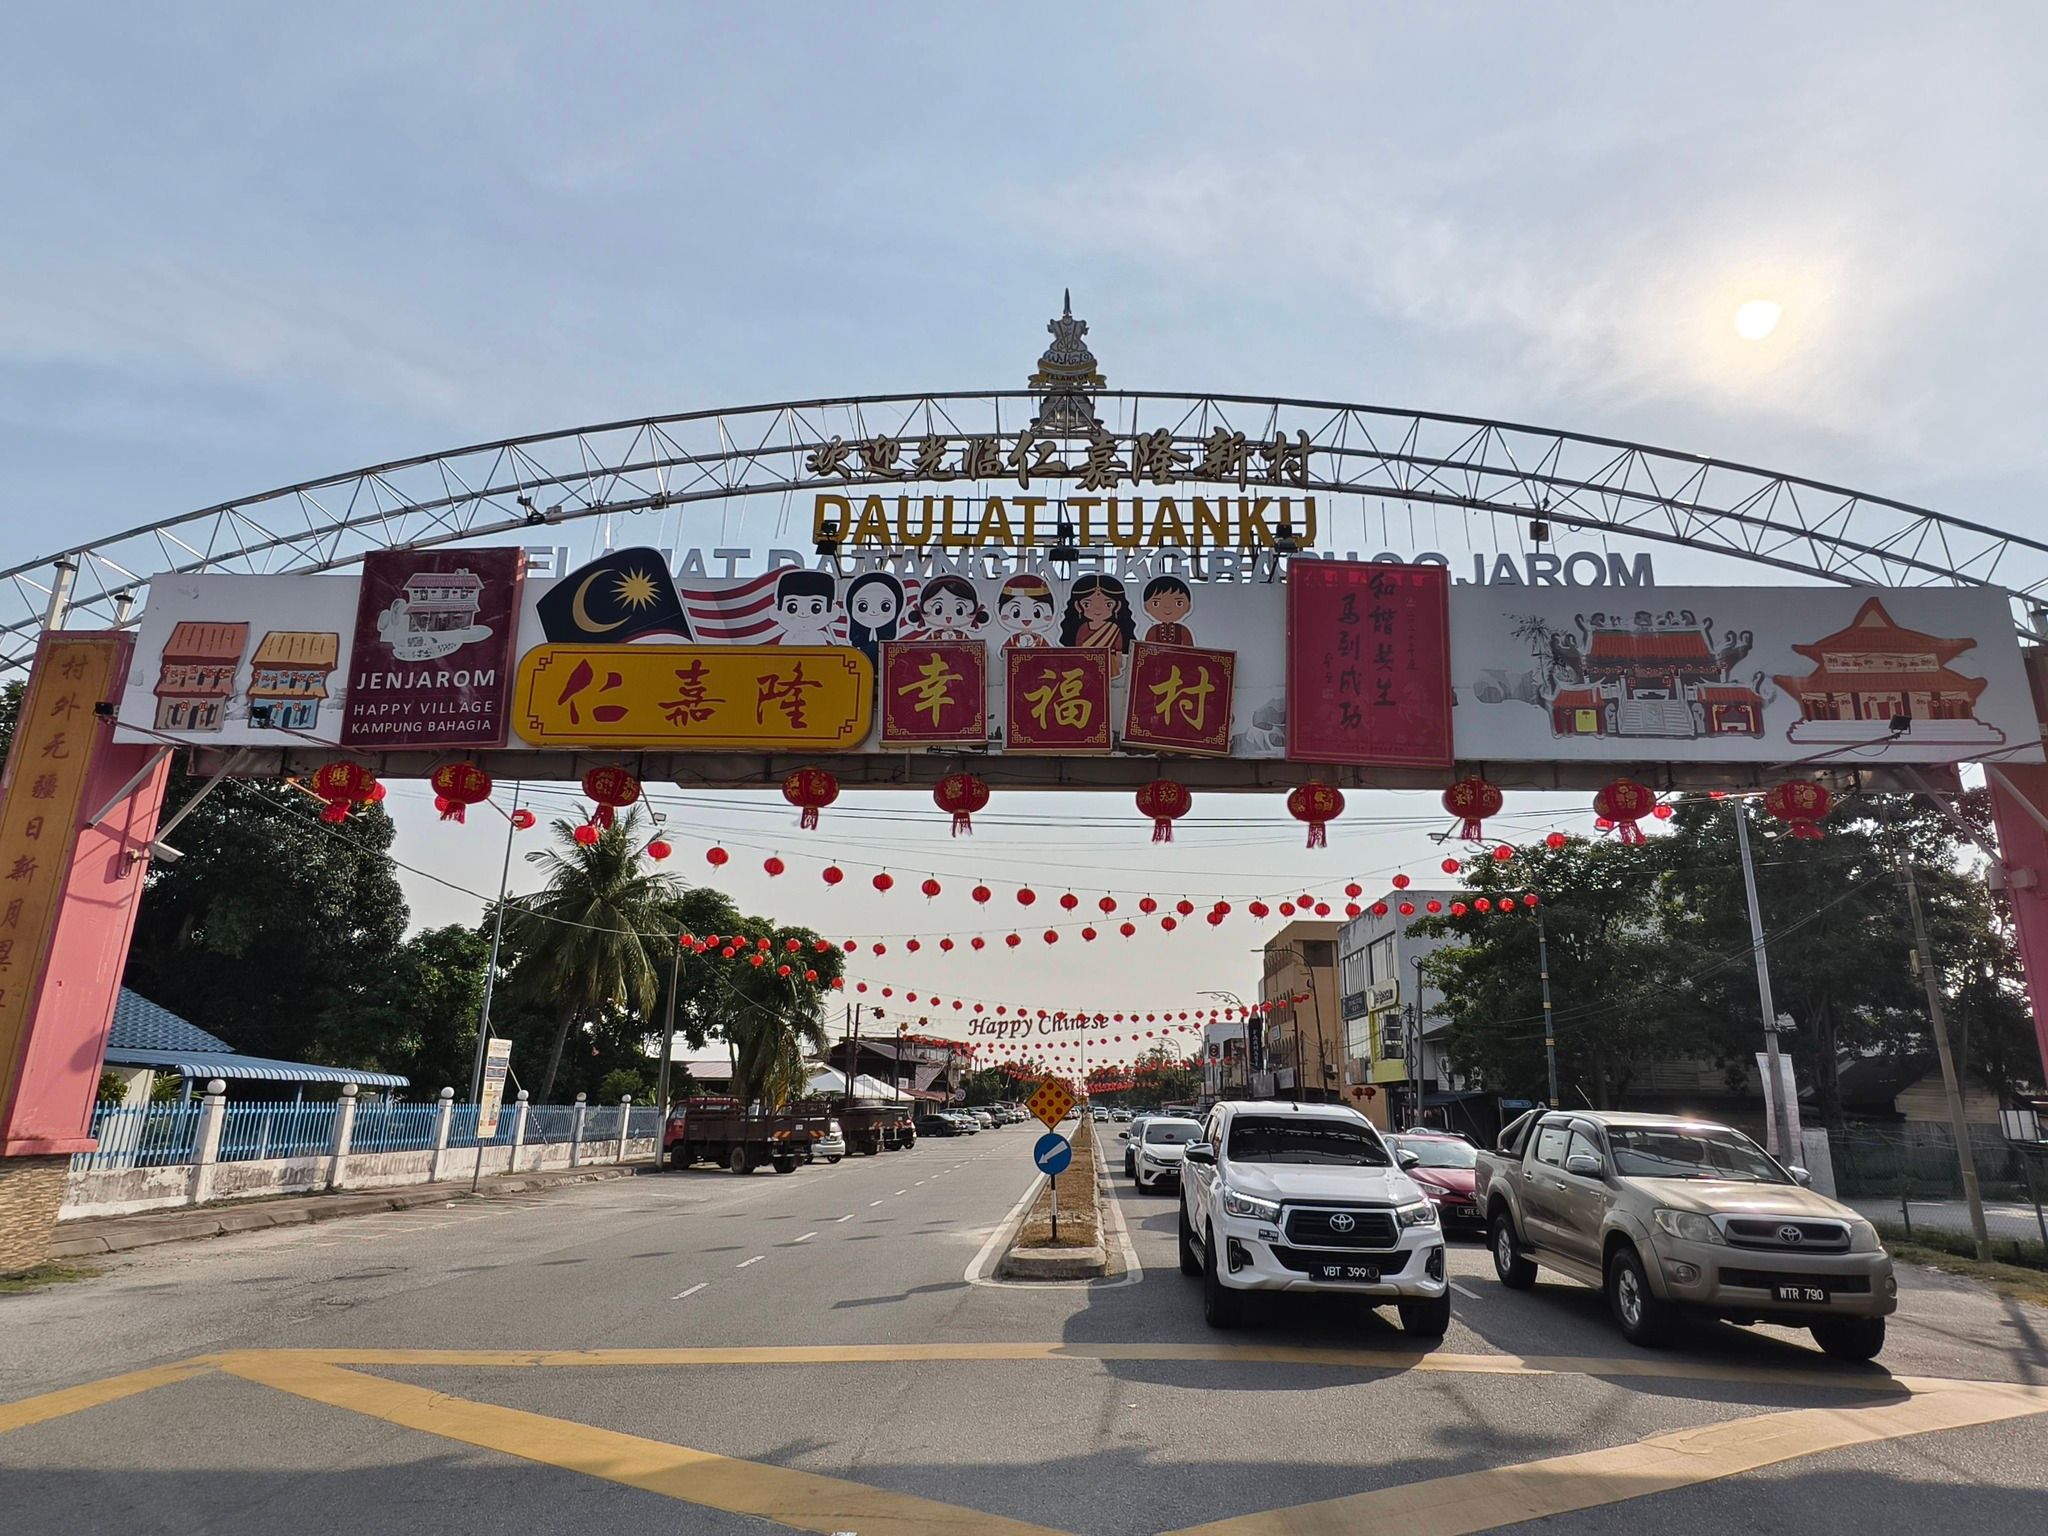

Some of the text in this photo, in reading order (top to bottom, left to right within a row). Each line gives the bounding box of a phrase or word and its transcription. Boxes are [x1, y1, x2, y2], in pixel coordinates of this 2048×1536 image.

[812, 494, 1317, 548] DAULAT TUANKU
[1456, 551, 1655, 587] JAROM
[356, 669, 496, 690] JENJAROM
[558, 659, 823, 728] 仁嘉隆
[897, 653, 1215, 731] 幸 福 村
[353, 700, 493, 716] HAPPY VILLAGE
[351, 719, 492, 734] KAMPUNG BAHAGIA
[968, 1014, 1110, 1039] Happy Chinese
[1322, 1265, 1367, 1278] VBT 399
[1779, 1286, 1824, 1301] WTR 790
